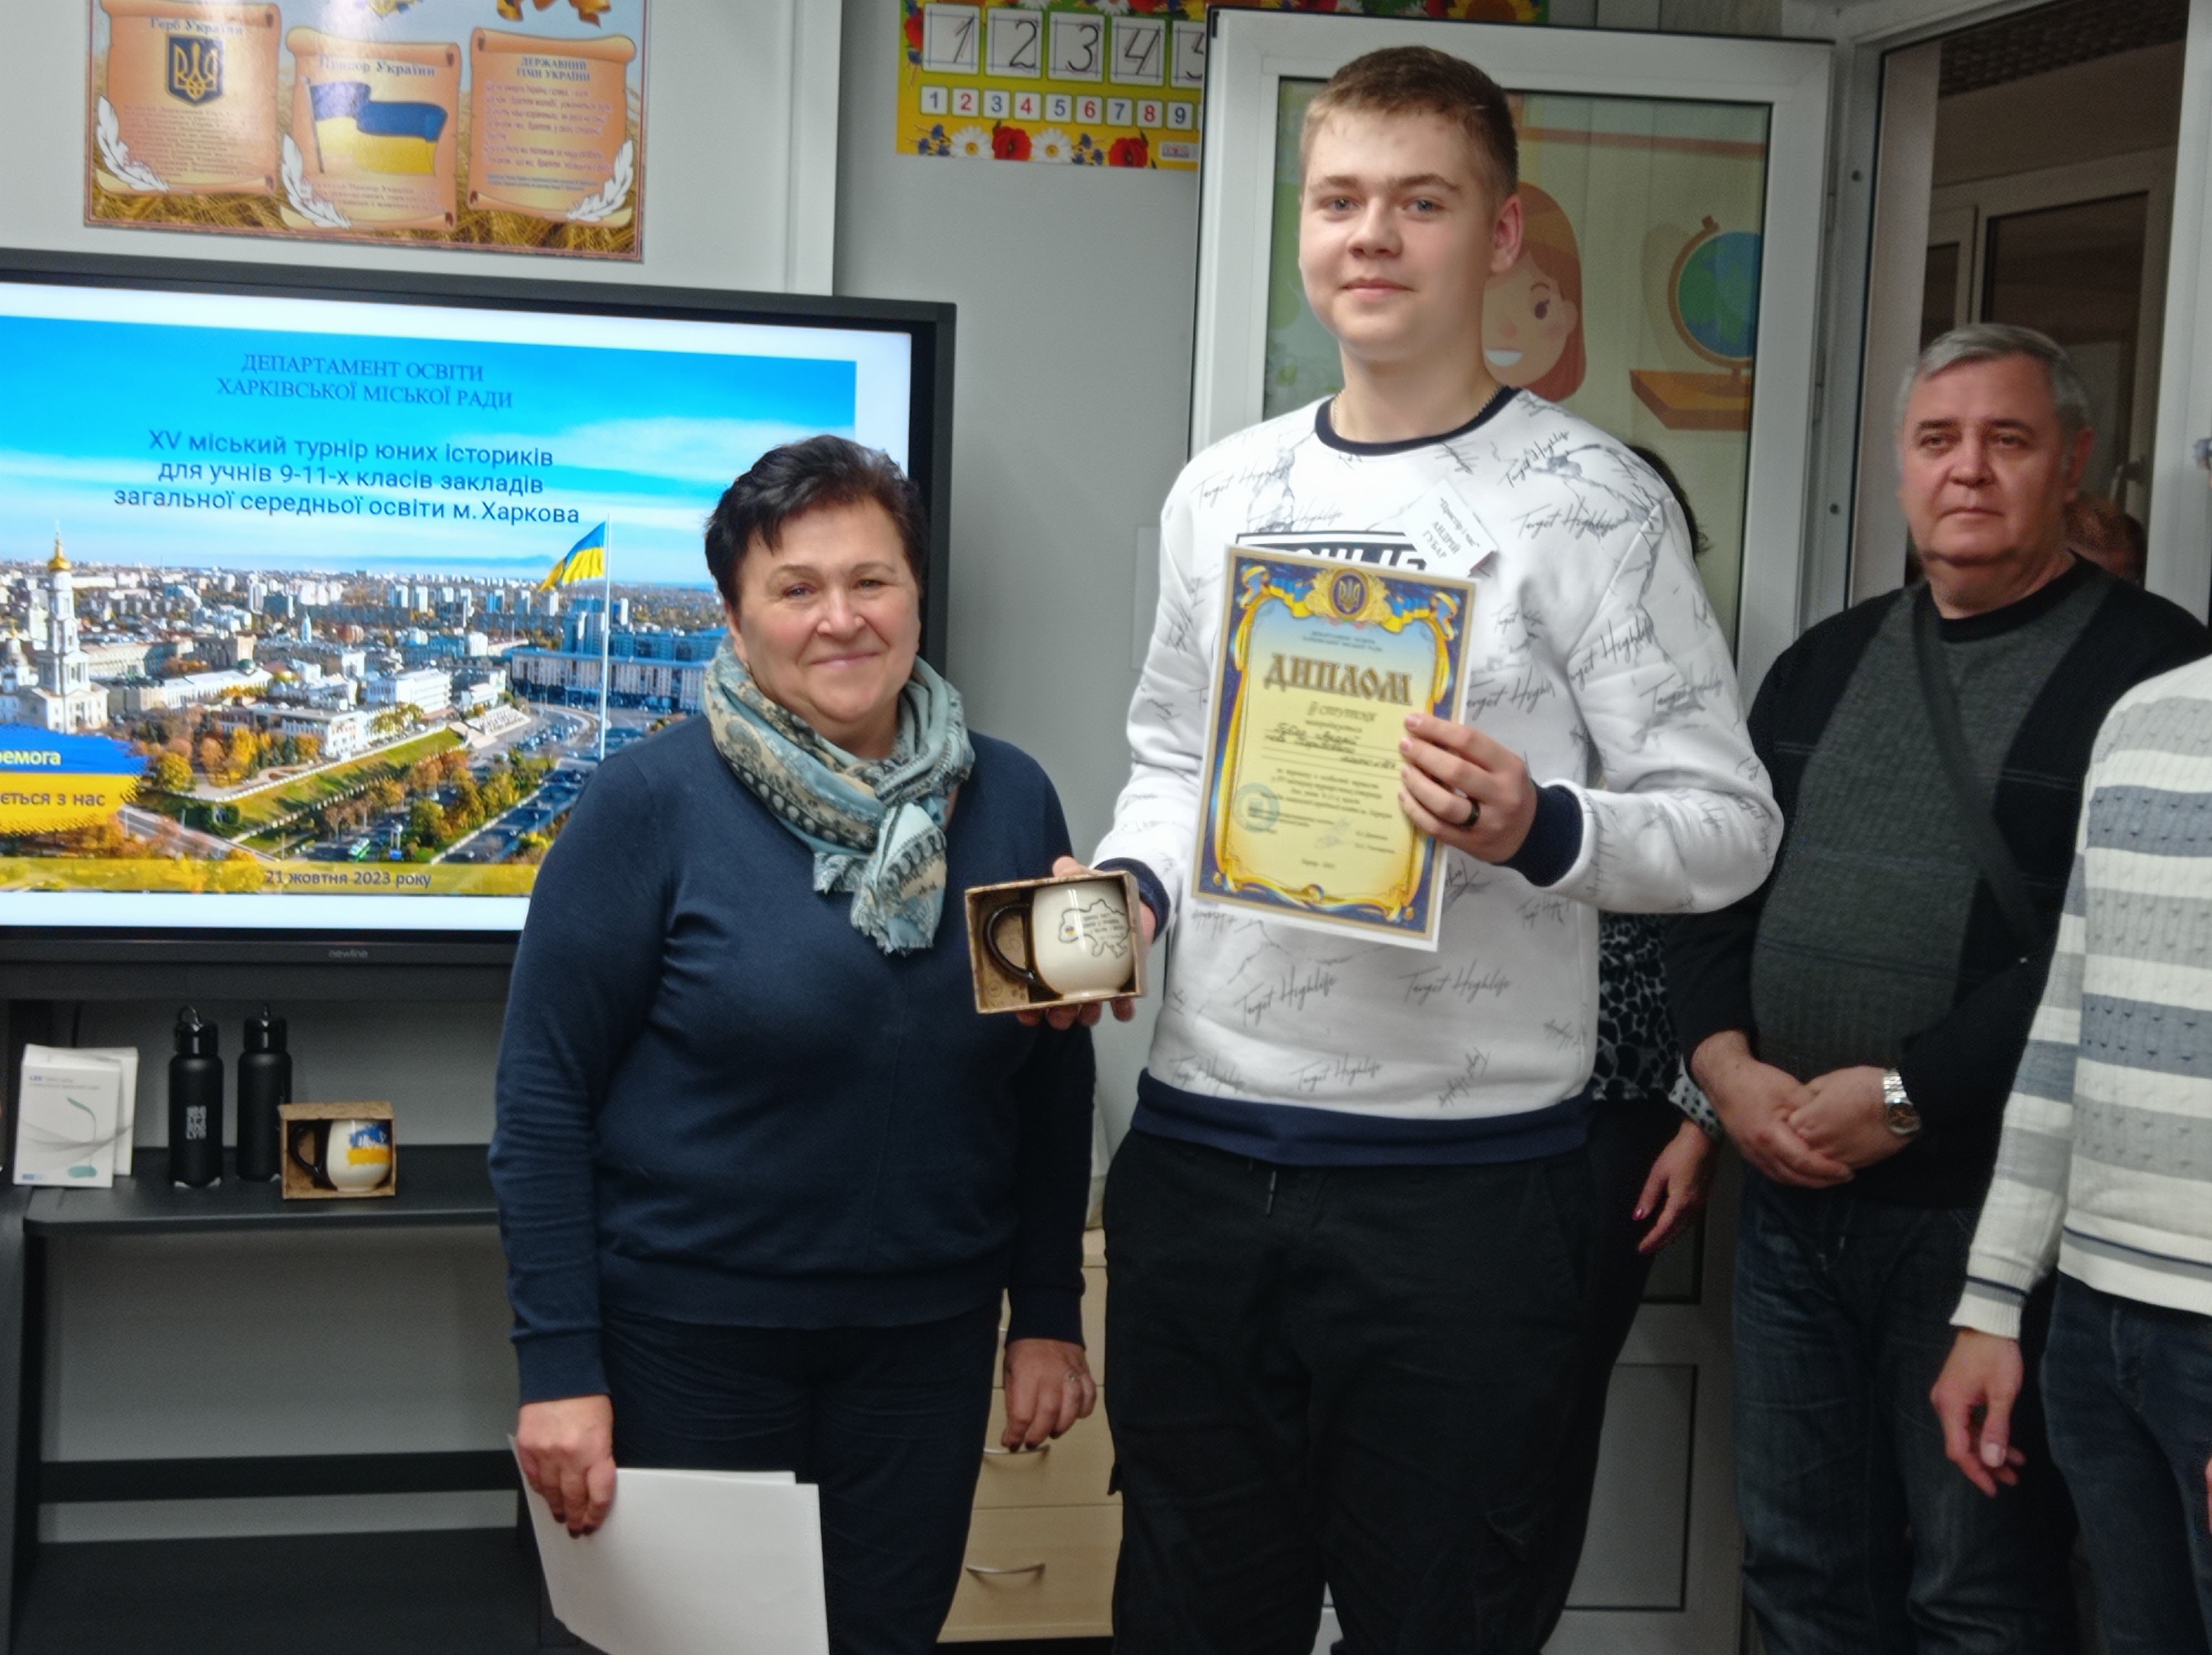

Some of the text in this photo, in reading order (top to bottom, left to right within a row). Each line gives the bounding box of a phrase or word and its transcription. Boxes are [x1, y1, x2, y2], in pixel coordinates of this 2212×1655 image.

[955, 15, 974, 63] 1
[1009, 19, 1038, 69] 2
[1067, 24, 1099, 72] 3
[1125, 29, 1160, 75] 4
[929, 93, 1186, 124] 1 2 3 4 5 6 7 8 9
[242, 353, 484, 382] ДЕПАРТАМЕНТ ОСВІТИ
[216, 378, 513, 410] ХАРКІВСЬКОЇ МІСЬКОЇ РАДИ
[189, 433, 286, 456] міський
[295, 438, 368, 462] турнір
[375, 443, 438, 462] юних
[445, 443, 554, 469] істориків
[158, 462, 544, 497] для учнів 9-11-х класів закладів
[114, 489, 580, 525] загальної середньої освіти м. Харкова
[1264, 652, 1413, 706] ДИПЛОМ
[57, 793, 66, 806] з
[73, 794, 106, 807] нас
[266, 870, 431, 889] 21 жовтня 2023 року
